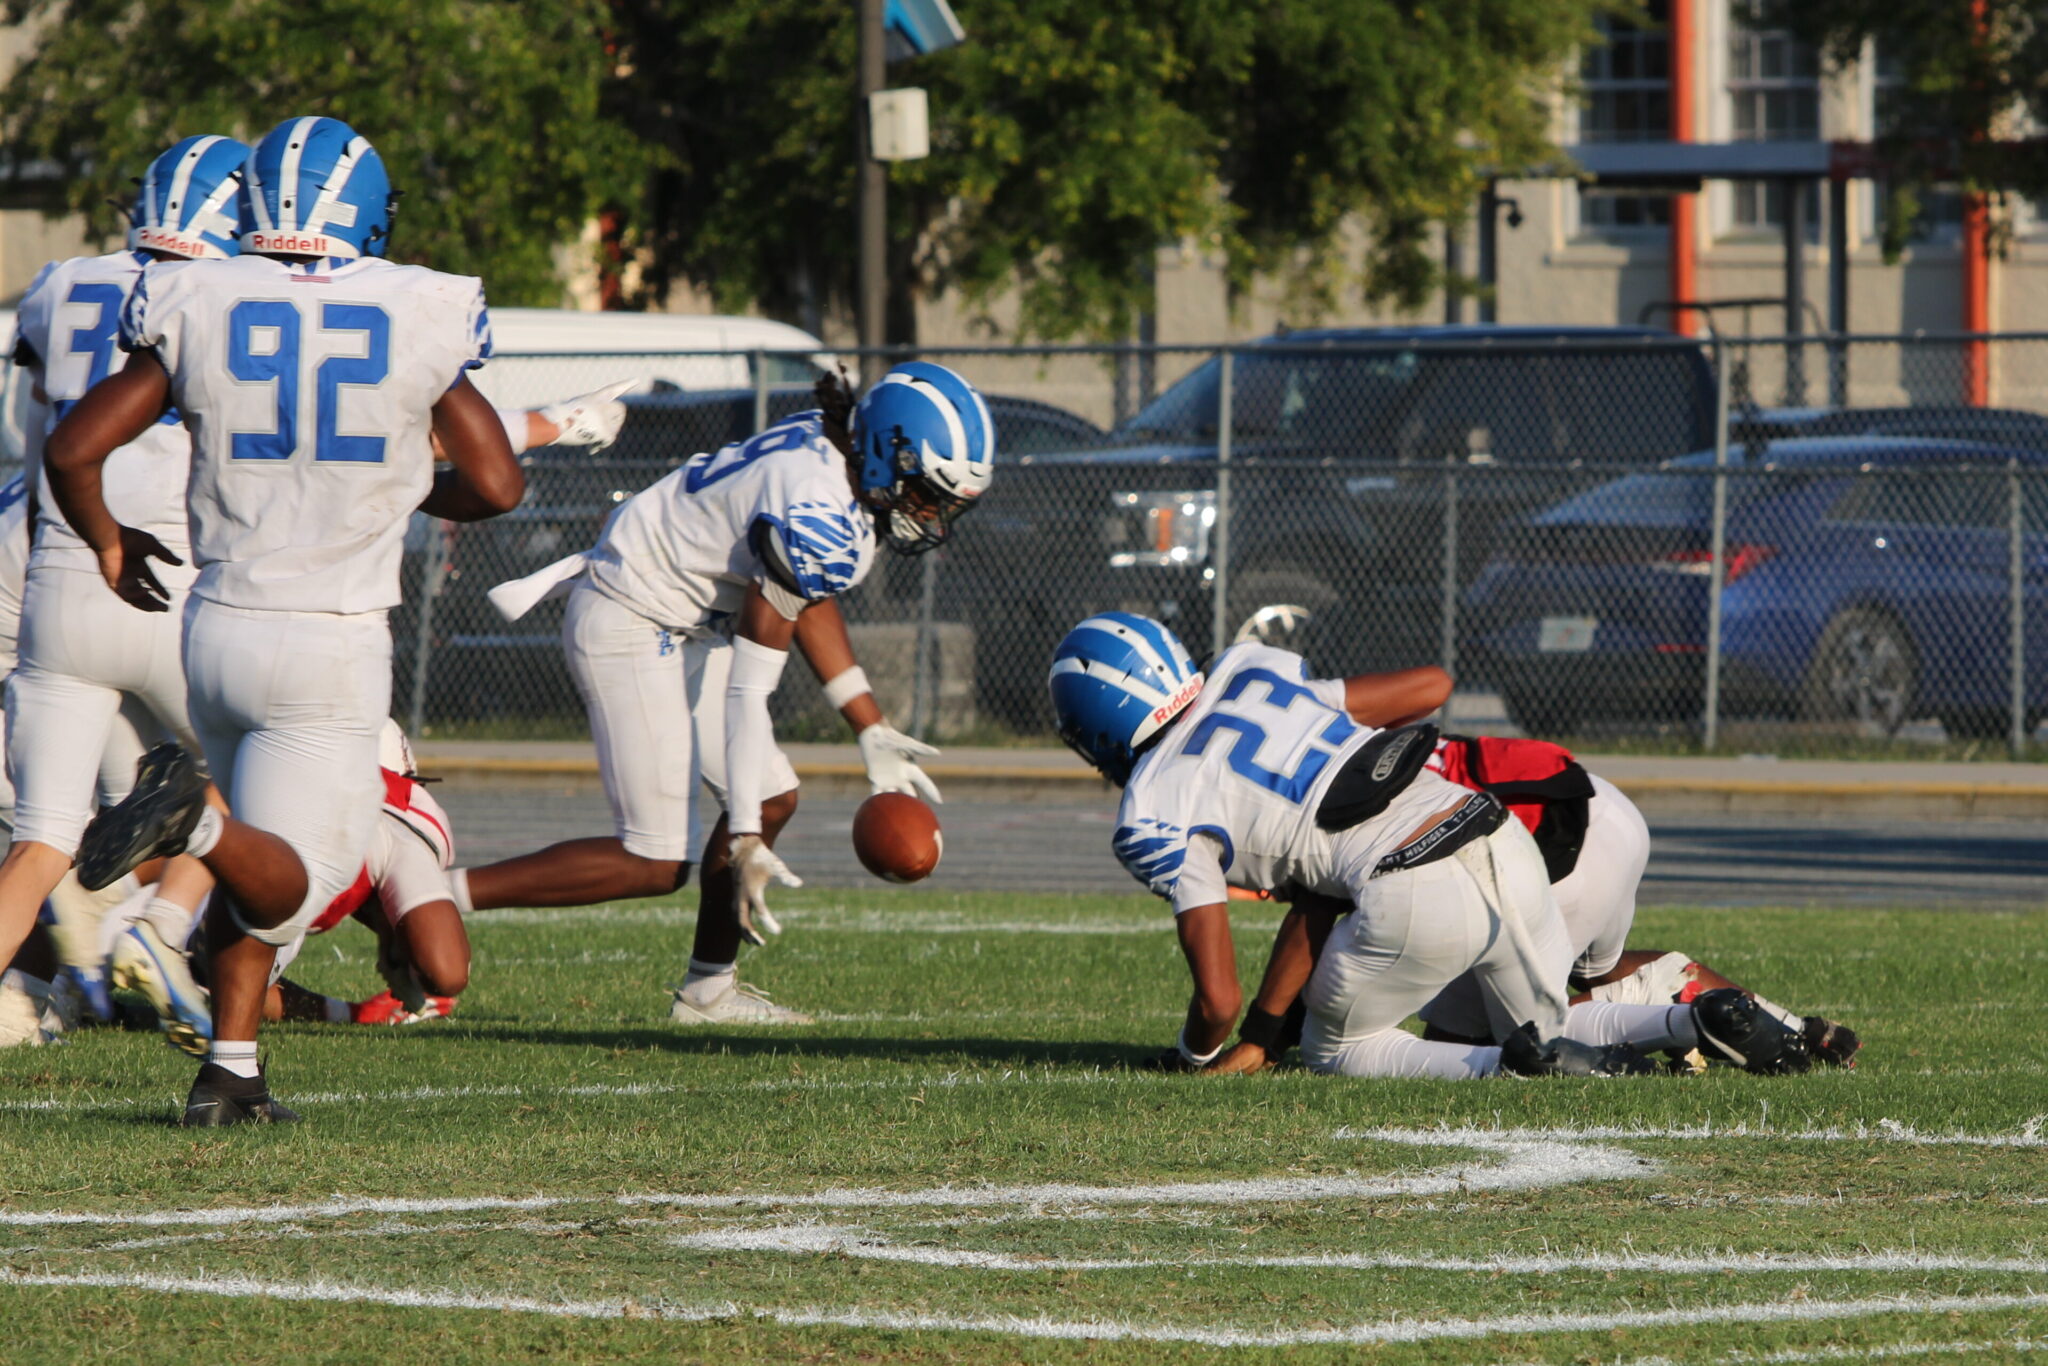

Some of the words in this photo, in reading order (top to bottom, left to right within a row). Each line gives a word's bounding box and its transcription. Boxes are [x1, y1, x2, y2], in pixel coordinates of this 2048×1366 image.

[139, 229, 204, 257] Riddell
[252, 234, 328, 252] Riddell
[223, 297, 391, 466] 92
[1179, 666, 1359, 806] 23
[1404, 825, 1449, 859] HILFIGER
